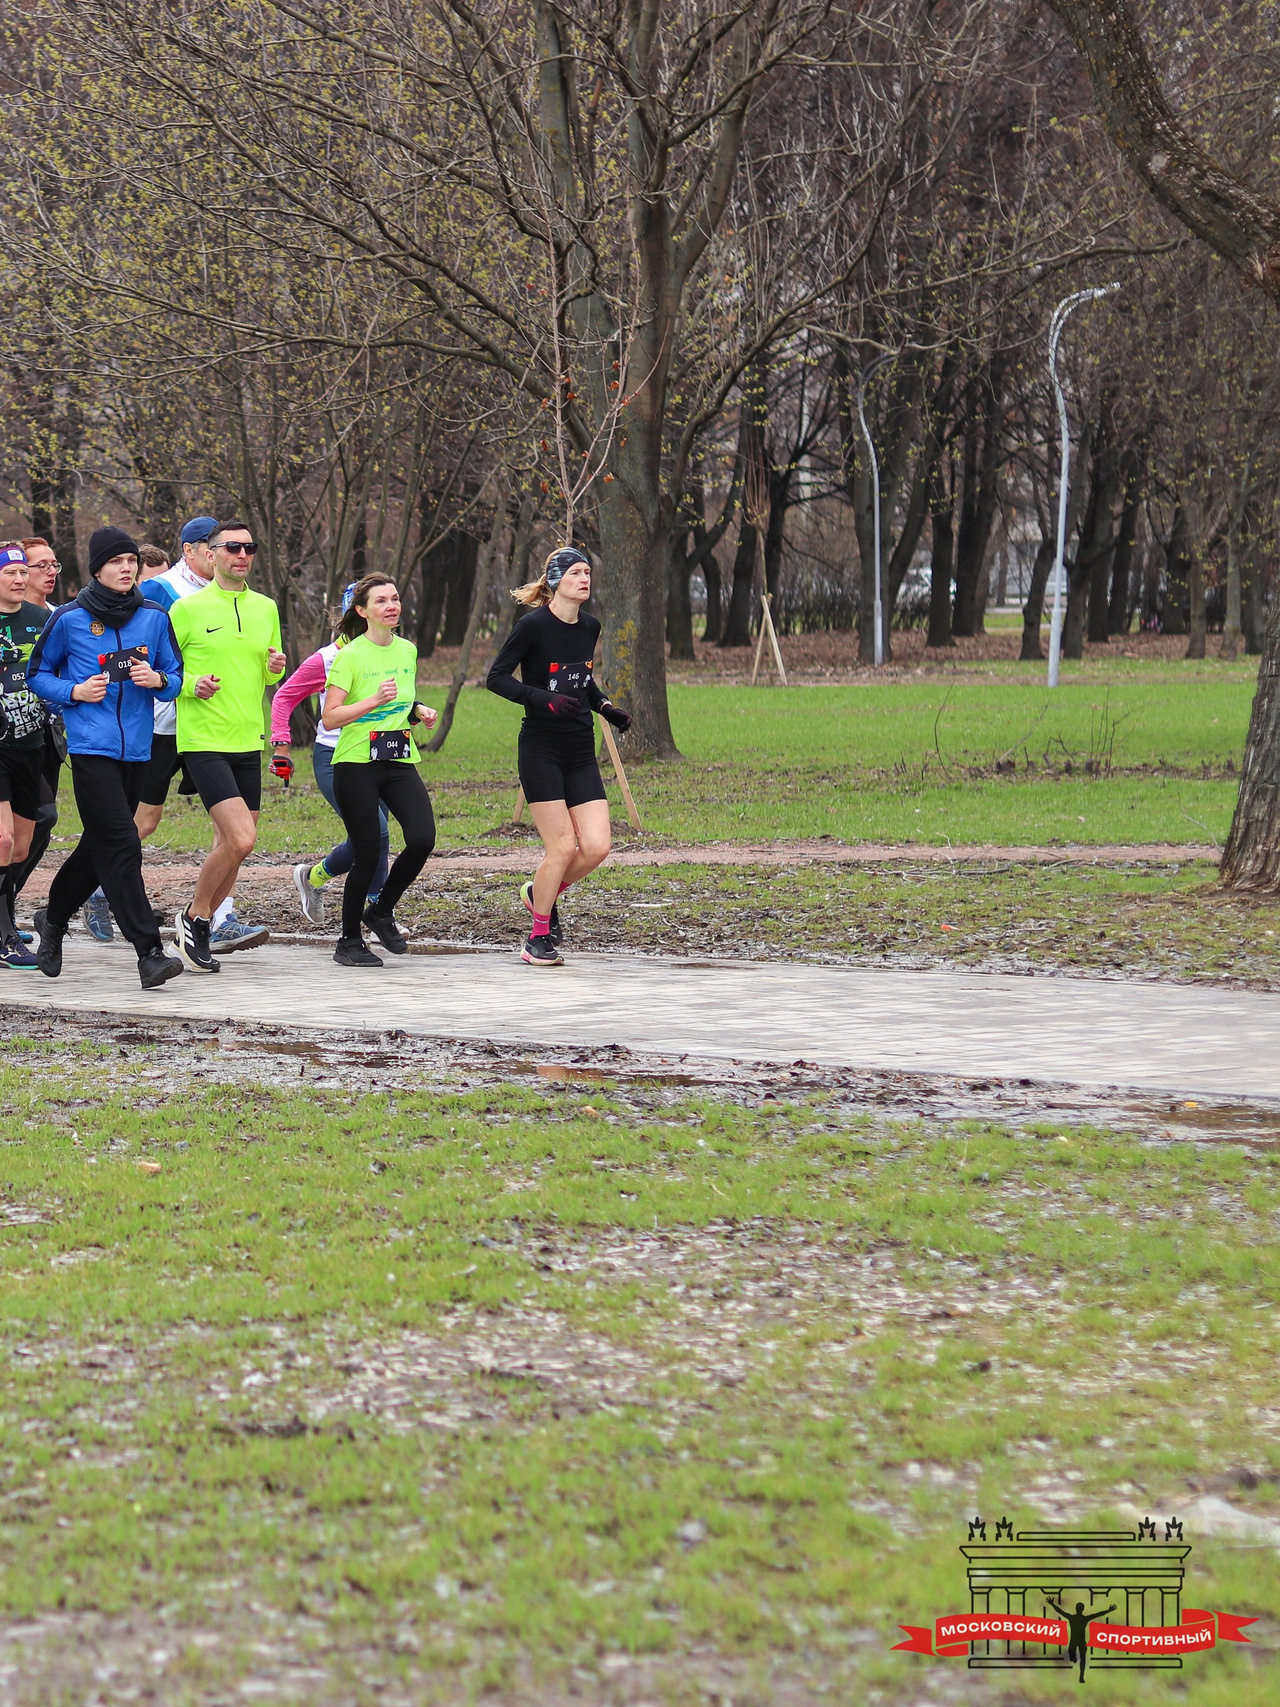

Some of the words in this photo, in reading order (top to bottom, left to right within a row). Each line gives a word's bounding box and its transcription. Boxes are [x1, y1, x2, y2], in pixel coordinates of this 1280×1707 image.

[118, 660, 133, 669] 018
[11, 672, 26, 681] 052
[386, 740, 398, 749] 044
